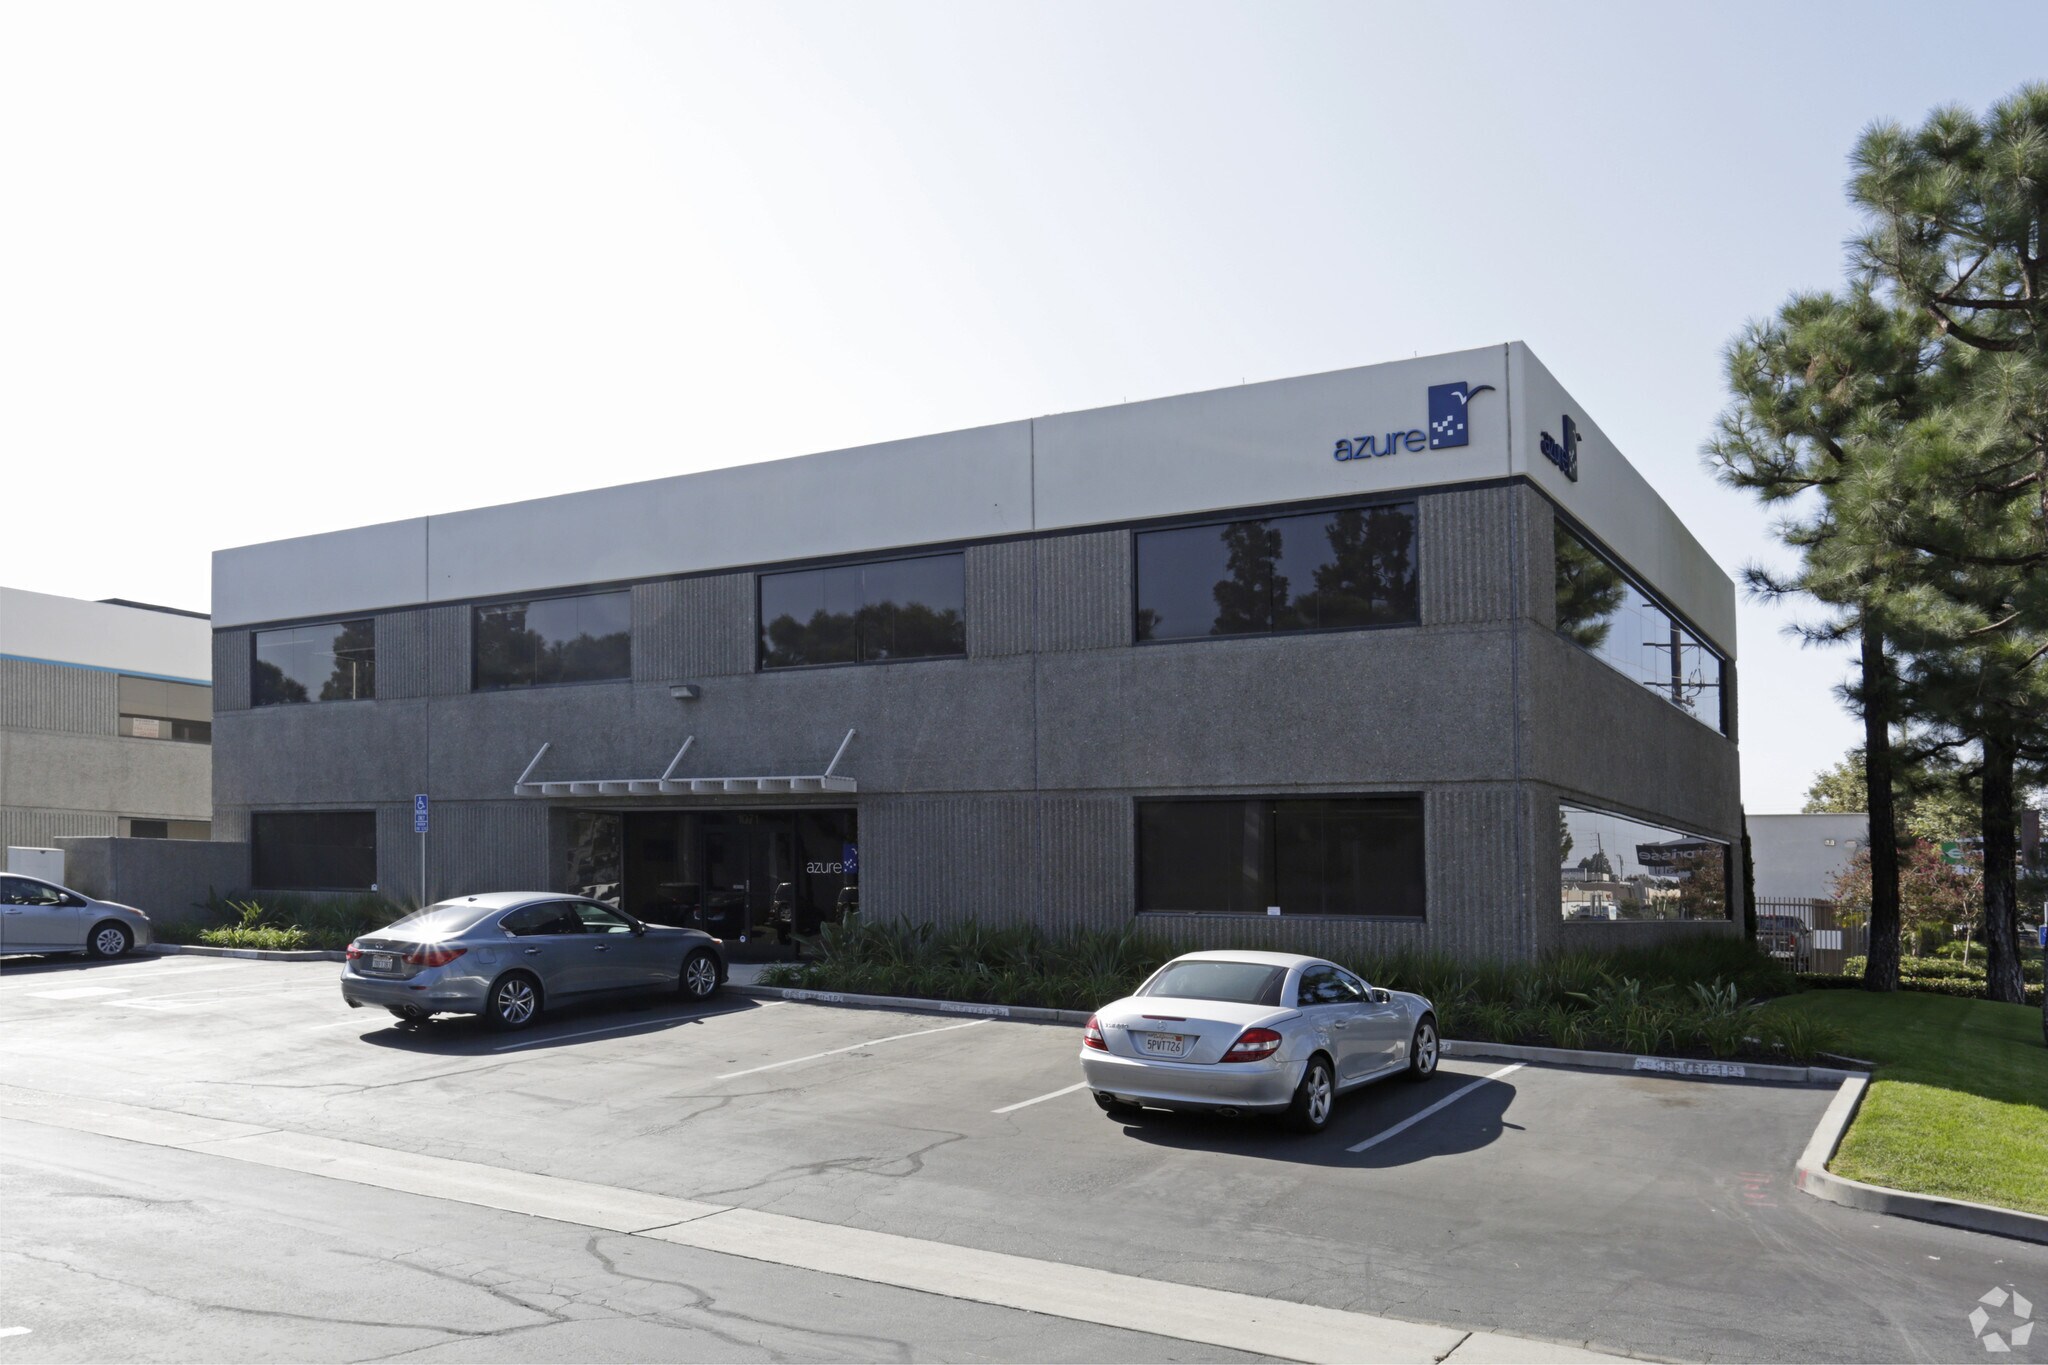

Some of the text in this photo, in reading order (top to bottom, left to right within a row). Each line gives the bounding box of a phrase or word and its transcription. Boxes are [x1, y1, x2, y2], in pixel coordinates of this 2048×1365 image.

[1333, 429, 1426, 461] azure
[806, 862, 842, 874] azure
[1147, 1040, 1181, 1052] 5PVT726
